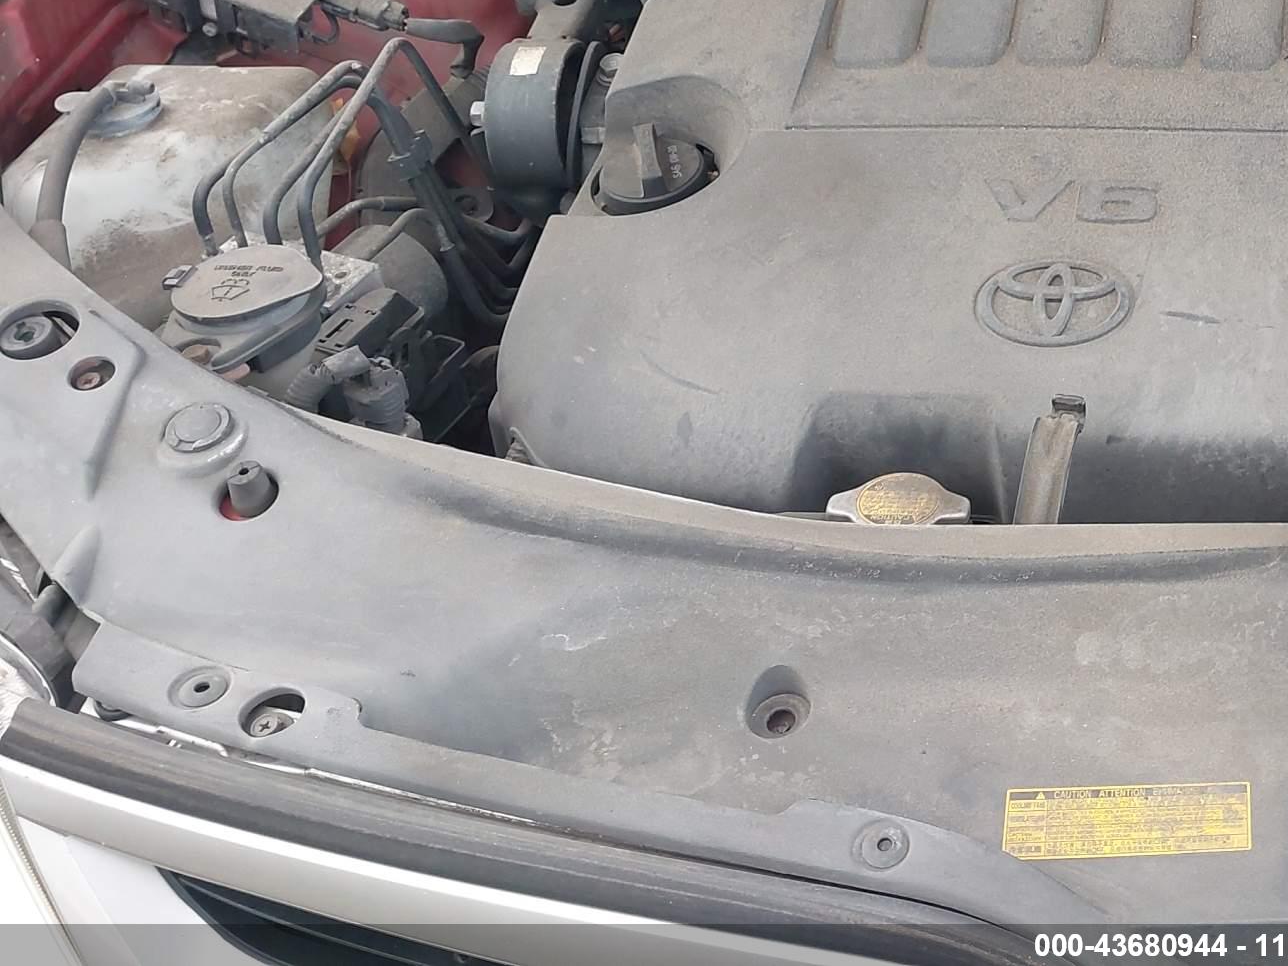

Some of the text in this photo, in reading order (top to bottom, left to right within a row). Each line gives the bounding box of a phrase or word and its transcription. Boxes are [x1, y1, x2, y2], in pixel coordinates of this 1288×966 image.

[984, 179, 1158, 225] V6
[1053, 789, 1092, 799] CAUTION
[1098, 788, 1146, 798] ATTENTION
